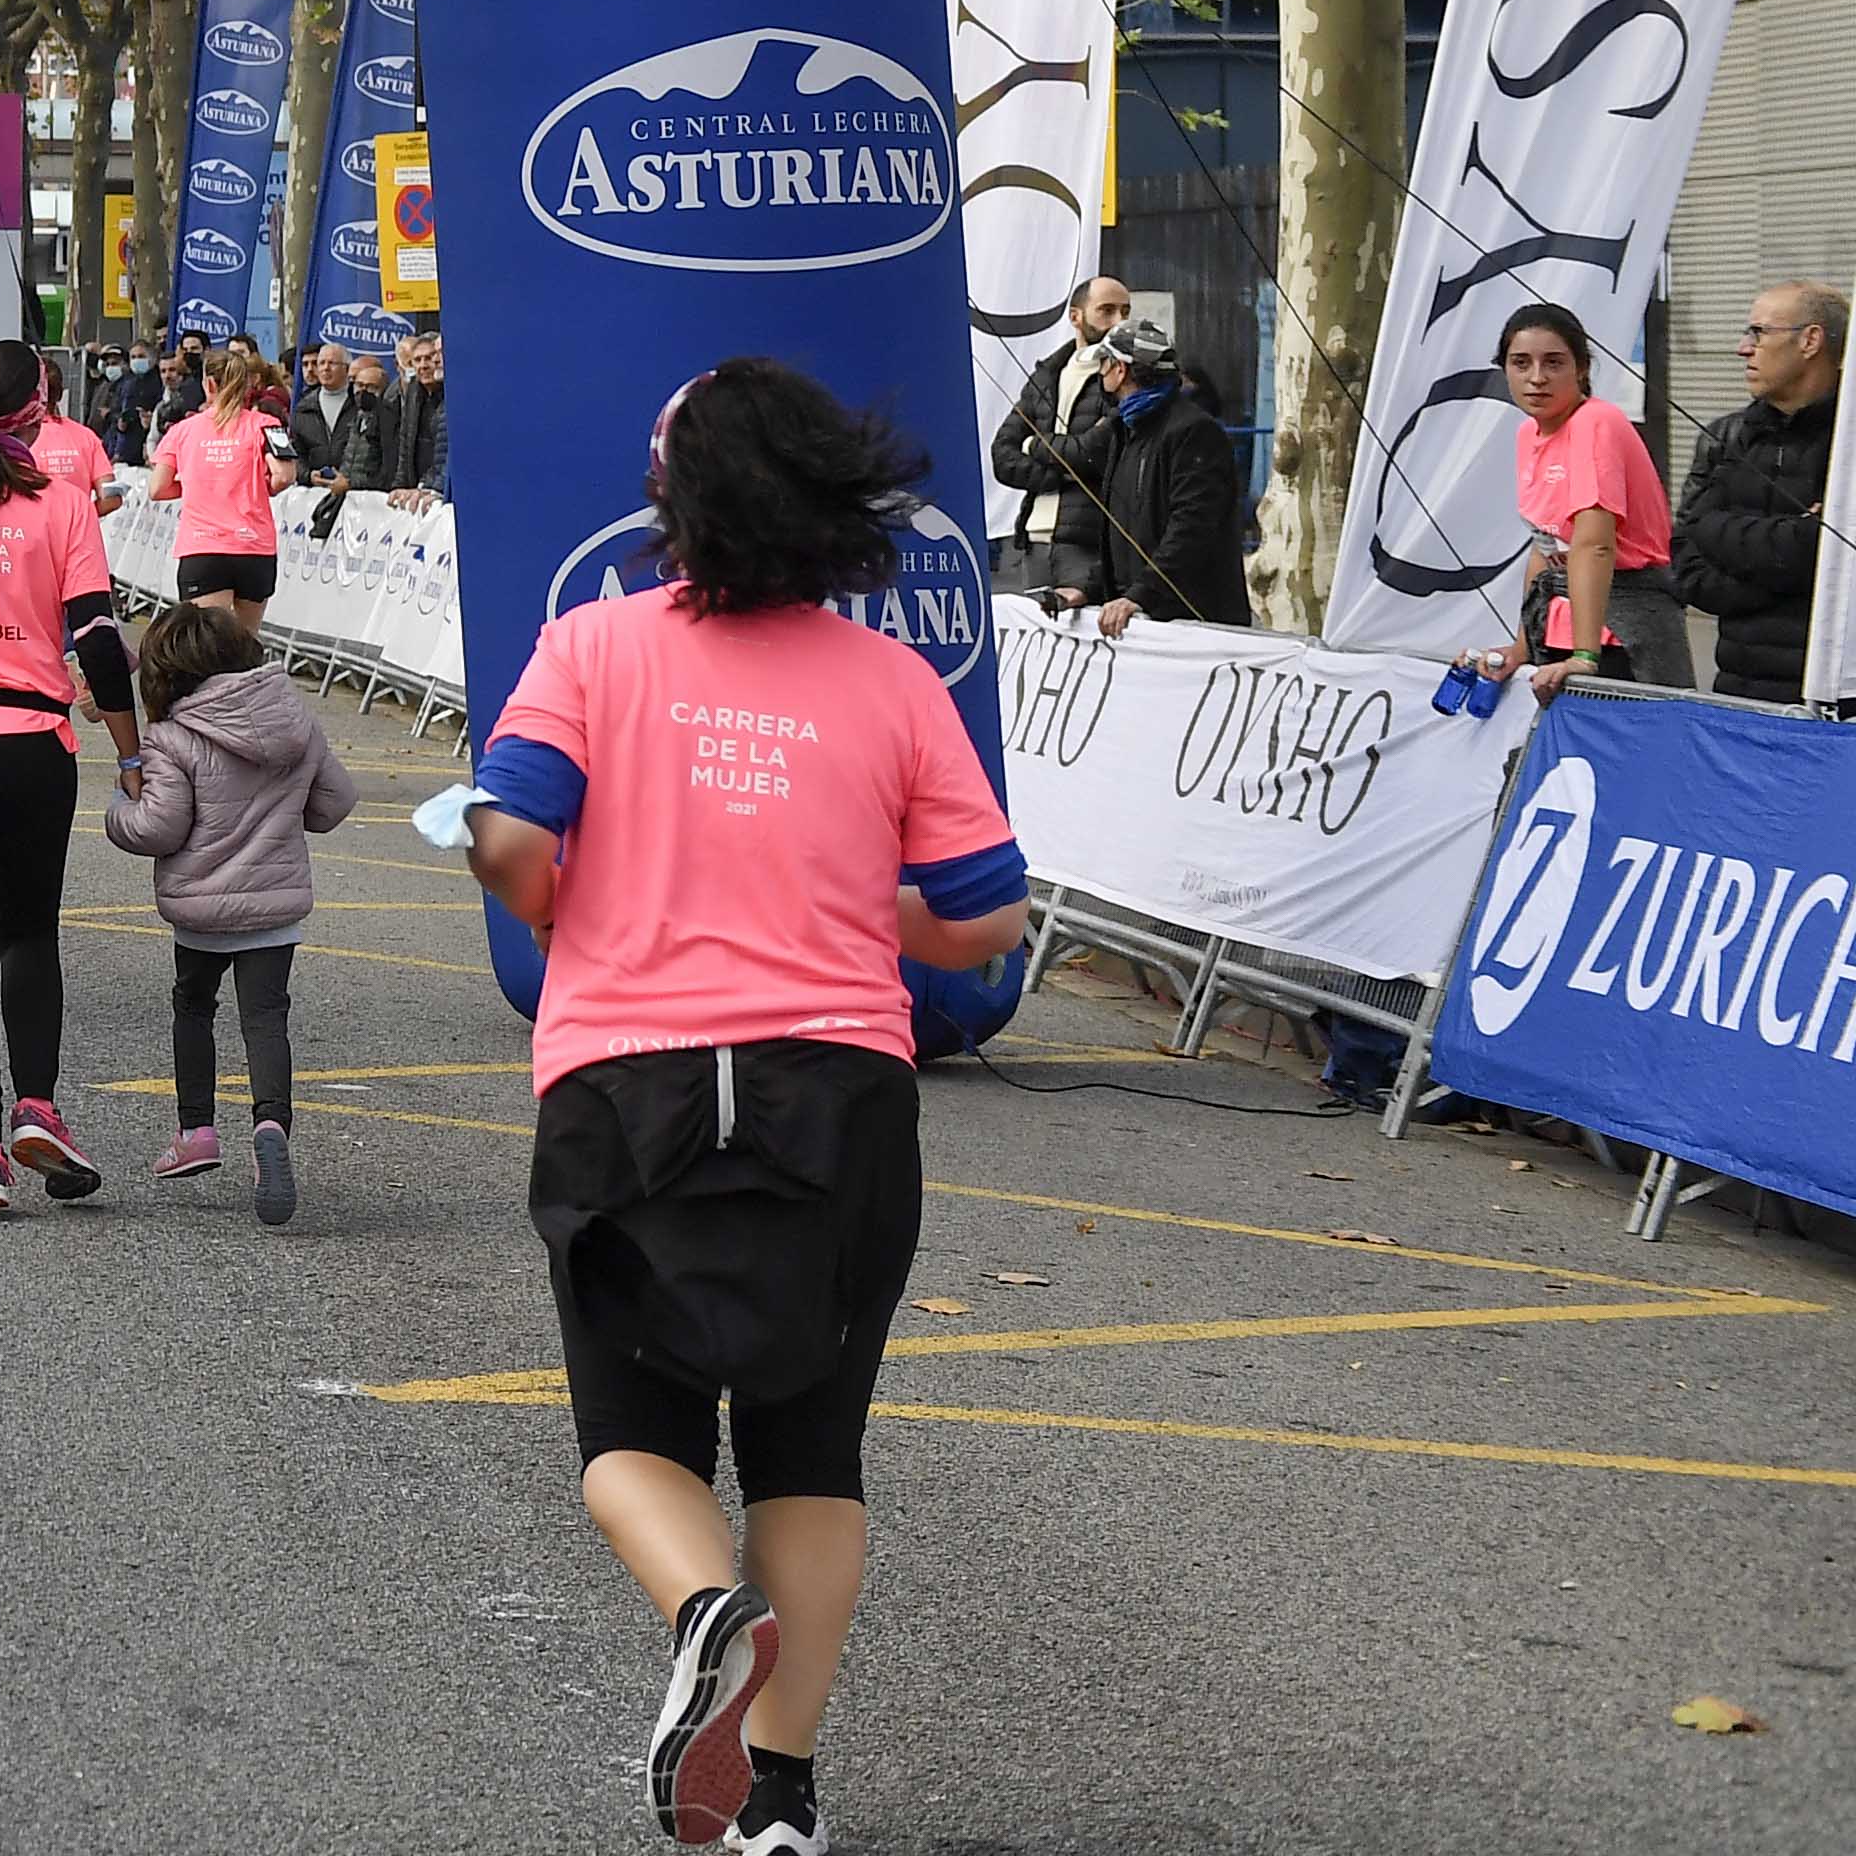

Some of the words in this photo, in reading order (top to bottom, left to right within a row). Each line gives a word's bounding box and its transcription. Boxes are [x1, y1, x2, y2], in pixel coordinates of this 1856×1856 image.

[211, 31, 276, 59] ASTURIANA
[361, 69, 415, 94] ASTUR
[199, 101, 261, 128] ASTURIANA
[631, 112, 796, 141] CENTRAL
[813, 111, 932, 135] LECHERA
[557, 127, 944, 216] ASTURIANA
[902, 552, 960, 573] HERA
[998, 627, 1116, 767] YSHO
[670, 701, 821, 743] CARRERA
[697, 739, 737, 763] DE
[750, 744, 787, 769] LA
[1175, 661, 1392, 836] OYSHO
[690, 766, 790, 799] MUJER
[725, 800, 757, 816] 2021
[1567, 836, 1856, 1064] ZURICH
